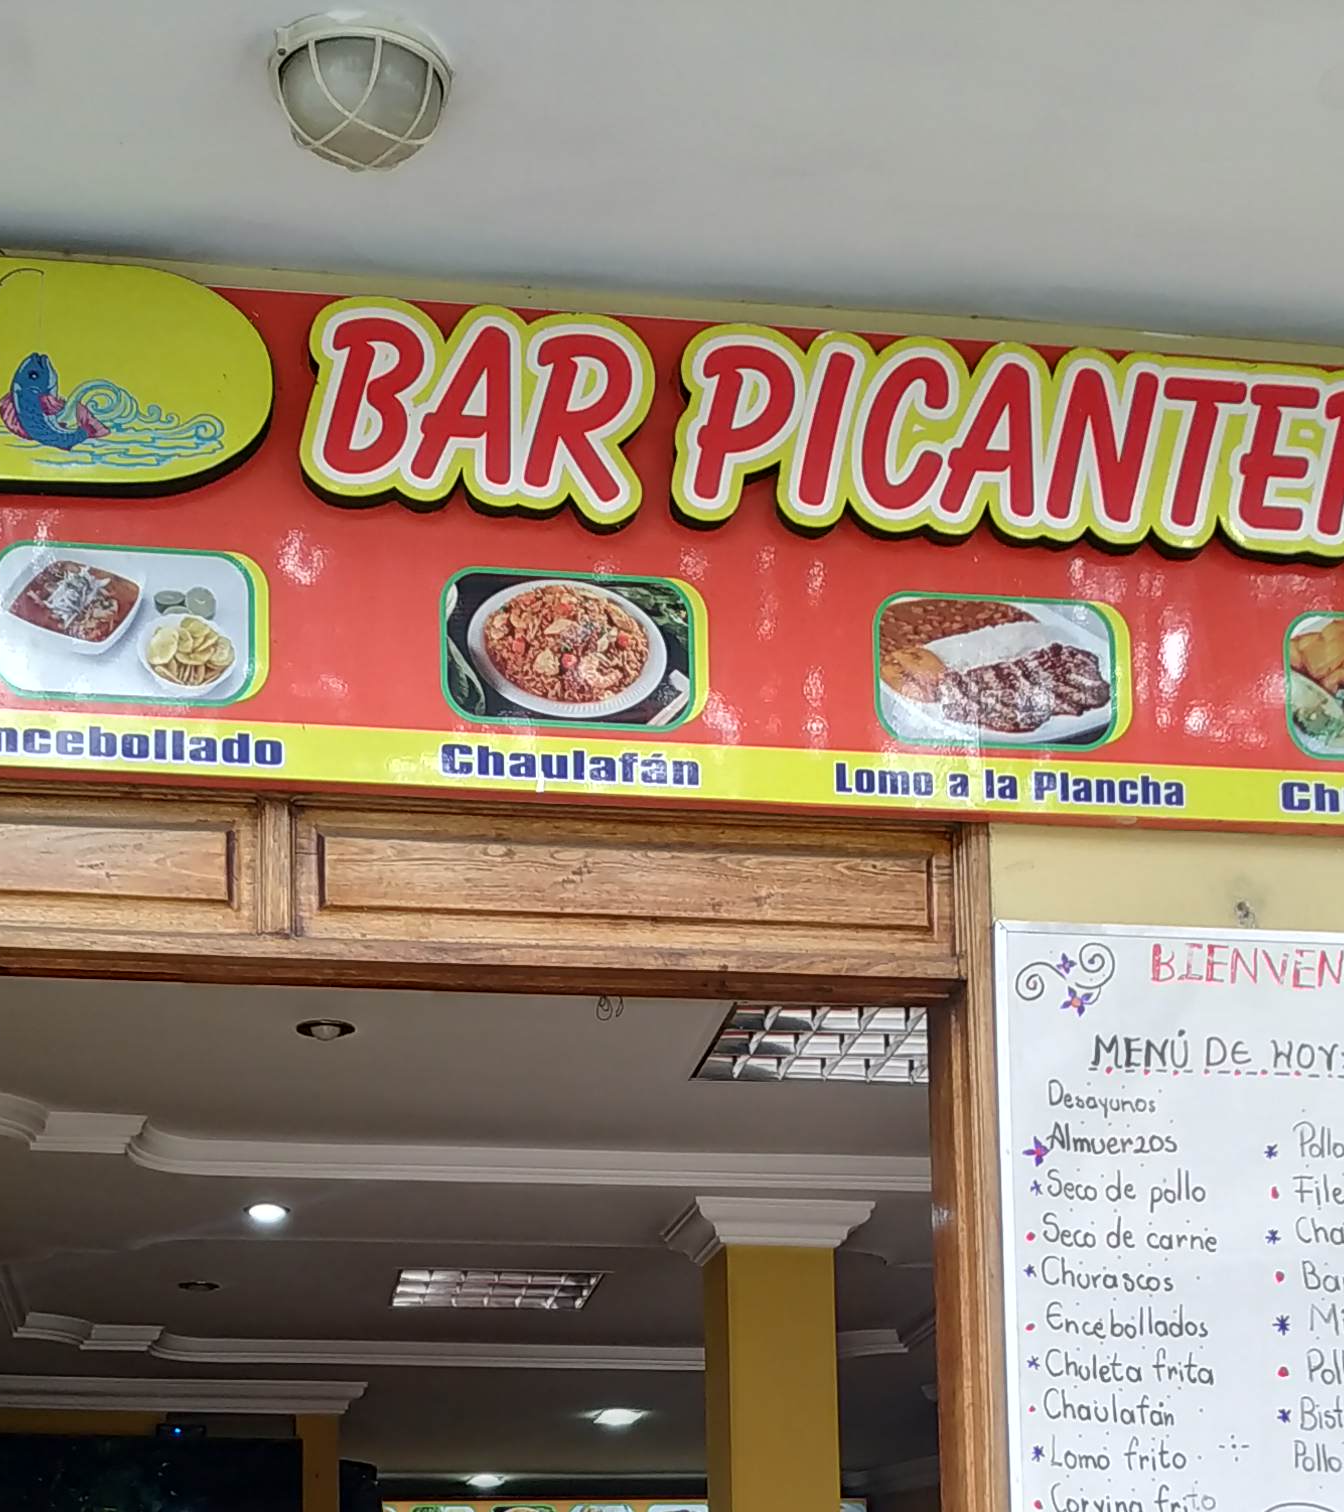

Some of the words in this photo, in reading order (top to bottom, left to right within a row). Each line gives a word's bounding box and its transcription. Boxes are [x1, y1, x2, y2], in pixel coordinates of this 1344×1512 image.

[313, 305, 644, 516] BAR
[441, 741, 700, 787] Chaulafán
[834, 763, 933, 799] Lomo
[946, 775, 969, 801] a
[981, 768, 1017, 803] la
[1032, 767, 1184, 810] Plancha
[1091, 1030, 1188, 1070] MENÚ
[1206, 1036, 1252, 1066] DE
[1048, 1080, 1157, 1119] Desayunos
[1046, 1123, 1178, 1155] Almuerzos
[1046, 1169, 1098, 1201] Seco
[1106, 1168, 1137, 1201] de
[1150, 1169, 1207, 1212] pollo
[1043, 1212, 1097, 1248] Seco
[1106, 1217, 1137, 1250] de
[1146, 1231, 1218, 1254] carne
[1045, 1301, 1209, 1339] Encebollados
[1045, 1348, 1143, 1382] Chuleta
[1153, 1347, 1215, 1387] frita
[1050, 1435, 1111, 1470] Lomo
[1123, 1437, 1187, 1471] frito
[1294, 1440, 1343, 1474] Pollo
